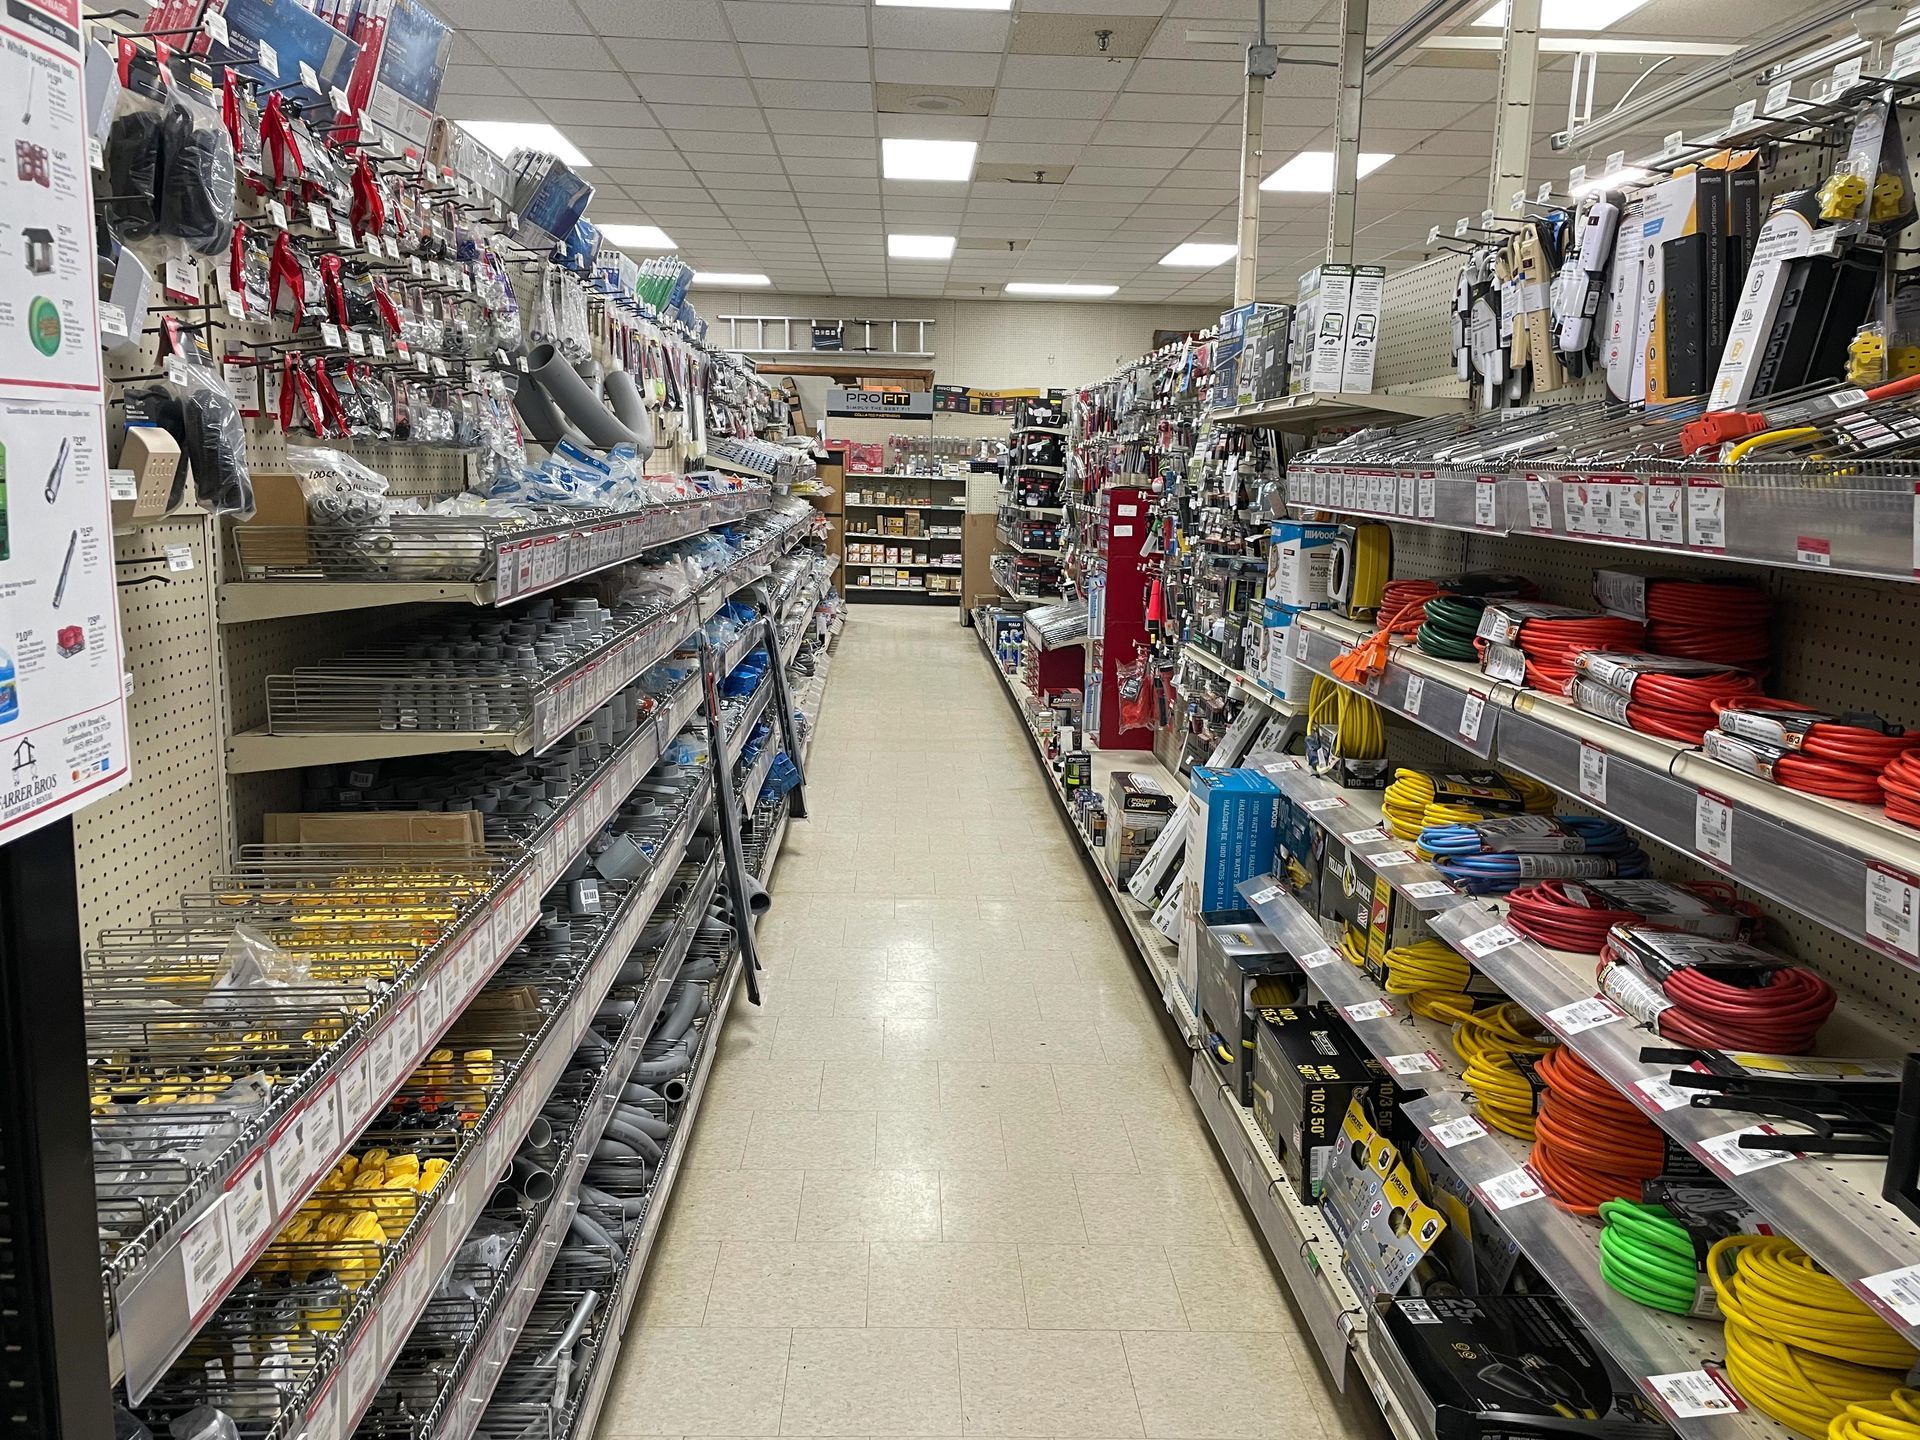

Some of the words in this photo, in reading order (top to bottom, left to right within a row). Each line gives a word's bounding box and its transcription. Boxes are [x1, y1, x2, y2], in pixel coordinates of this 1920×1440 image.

[30, 52, 60, 72] supplies
[1711, 237, 1717, 247] de
[1776, 232, 1788, 240] Power
[1752, 270, 1764, 293] 6
[1786, 733, 1800, 744] 16/3
[33, 774, 57, 796] BROS
[1348, 779, 1361, 787] 100
[1252, 800, 1260, 815] 1000
[1251, 816, 1259, 833] WATT
[1219, 843, 1227, 857] 1000
[1317, 1064, 1340, 1080] 10/3
[1310, 1087, 1326, 1114] 10/3
[1379, 1081, 1394, 1107] 10/3
[1349, 1112, 1364, 1130] VOLTEC
[1394, 1178, 1409, 1197] VOLTEC
[1401, 1302, 1419, 1311] 30
[1444, 1298, 1485, 1318] 25
